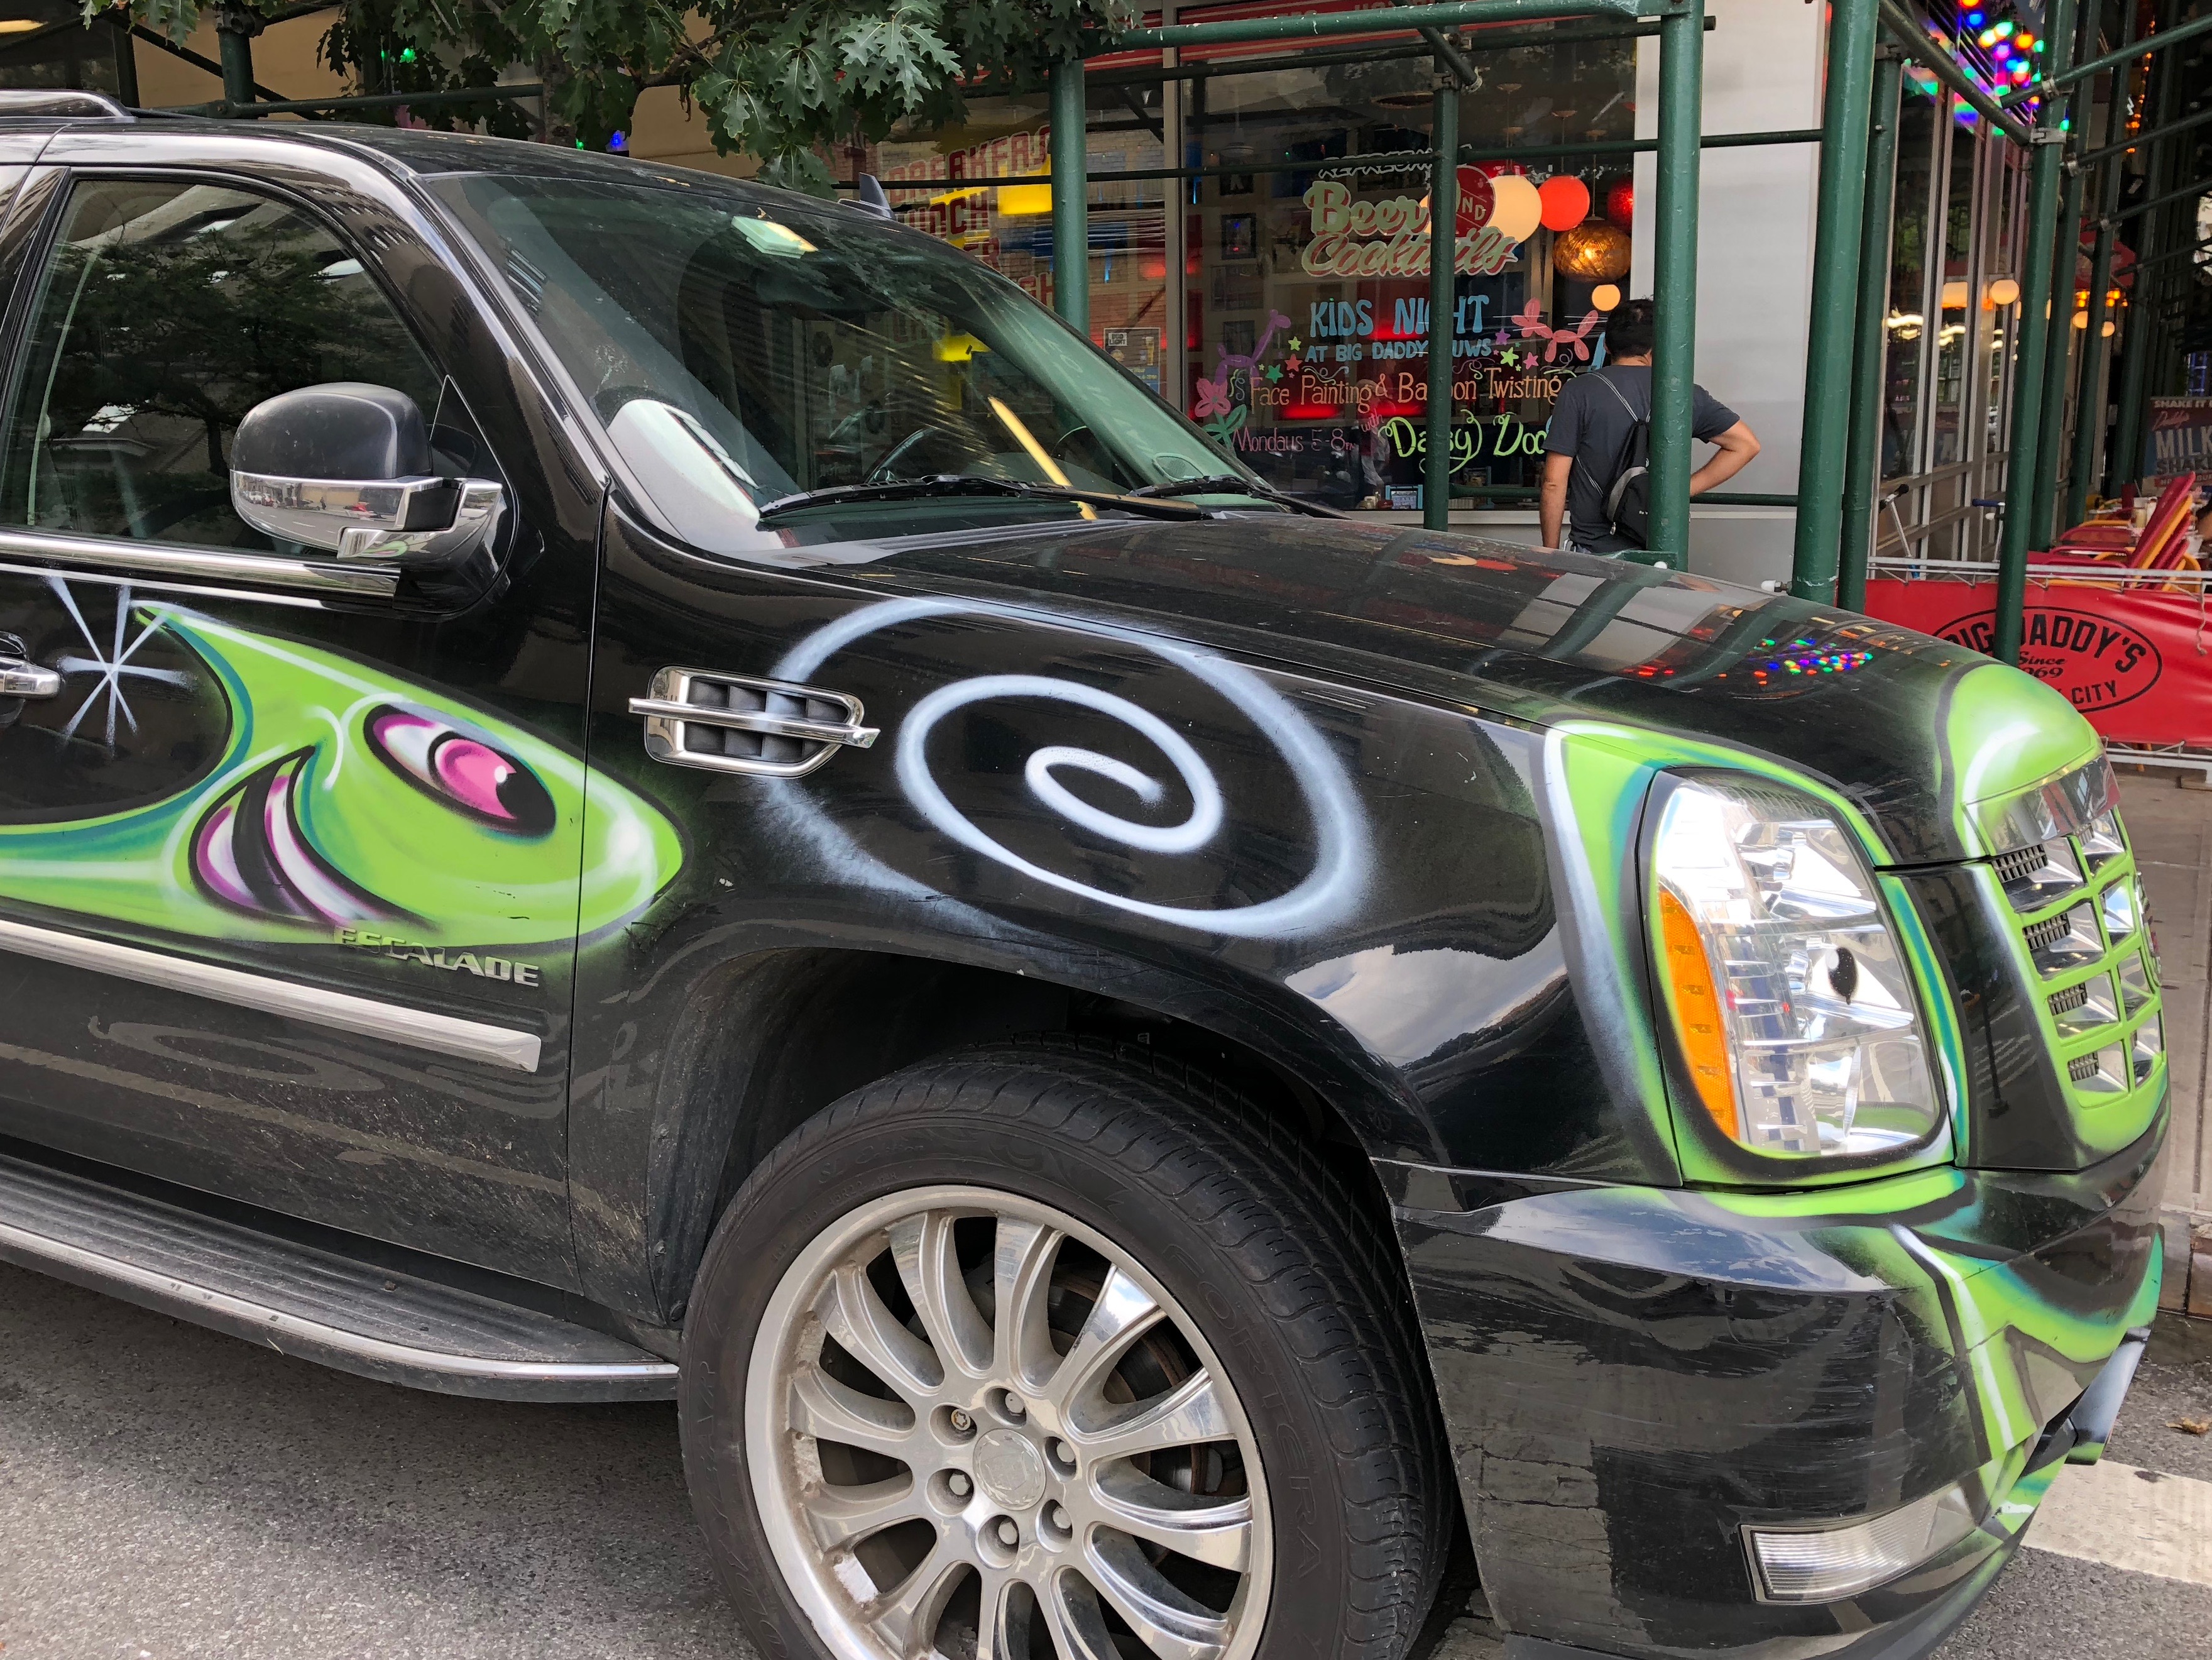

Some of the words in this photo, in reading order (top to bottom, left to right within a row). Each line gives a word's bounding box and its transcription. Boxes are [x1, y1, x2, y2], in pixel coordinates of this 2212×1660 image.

[1303, 180, 1431, 236] Beer
[1309, 298, 1374, 338] KIDS
[1393, 294, 1490, 335] NIHT
[1305, 345, 1328, 363] AT
[1335, 343, 1363, 362] BIG
[1452, 338, 1492, 358] UWS
[1250, 376, 1289, 414] Face
[1300, 374, 1372, 414] Painting
[1375, 373, 1388, 397] &
[1484, 367, 1562, 406] Twisting
[1360, 409, 1384, 433] with
[2155, 424, 2212, 459] MILK
[2018, 613, 2147, 674] ADDY'S
[2019, 651, 2066, 666] Since
[2071, 679, 2118, 705] CITY
[337, 927, 540, 987] ESCALADE
